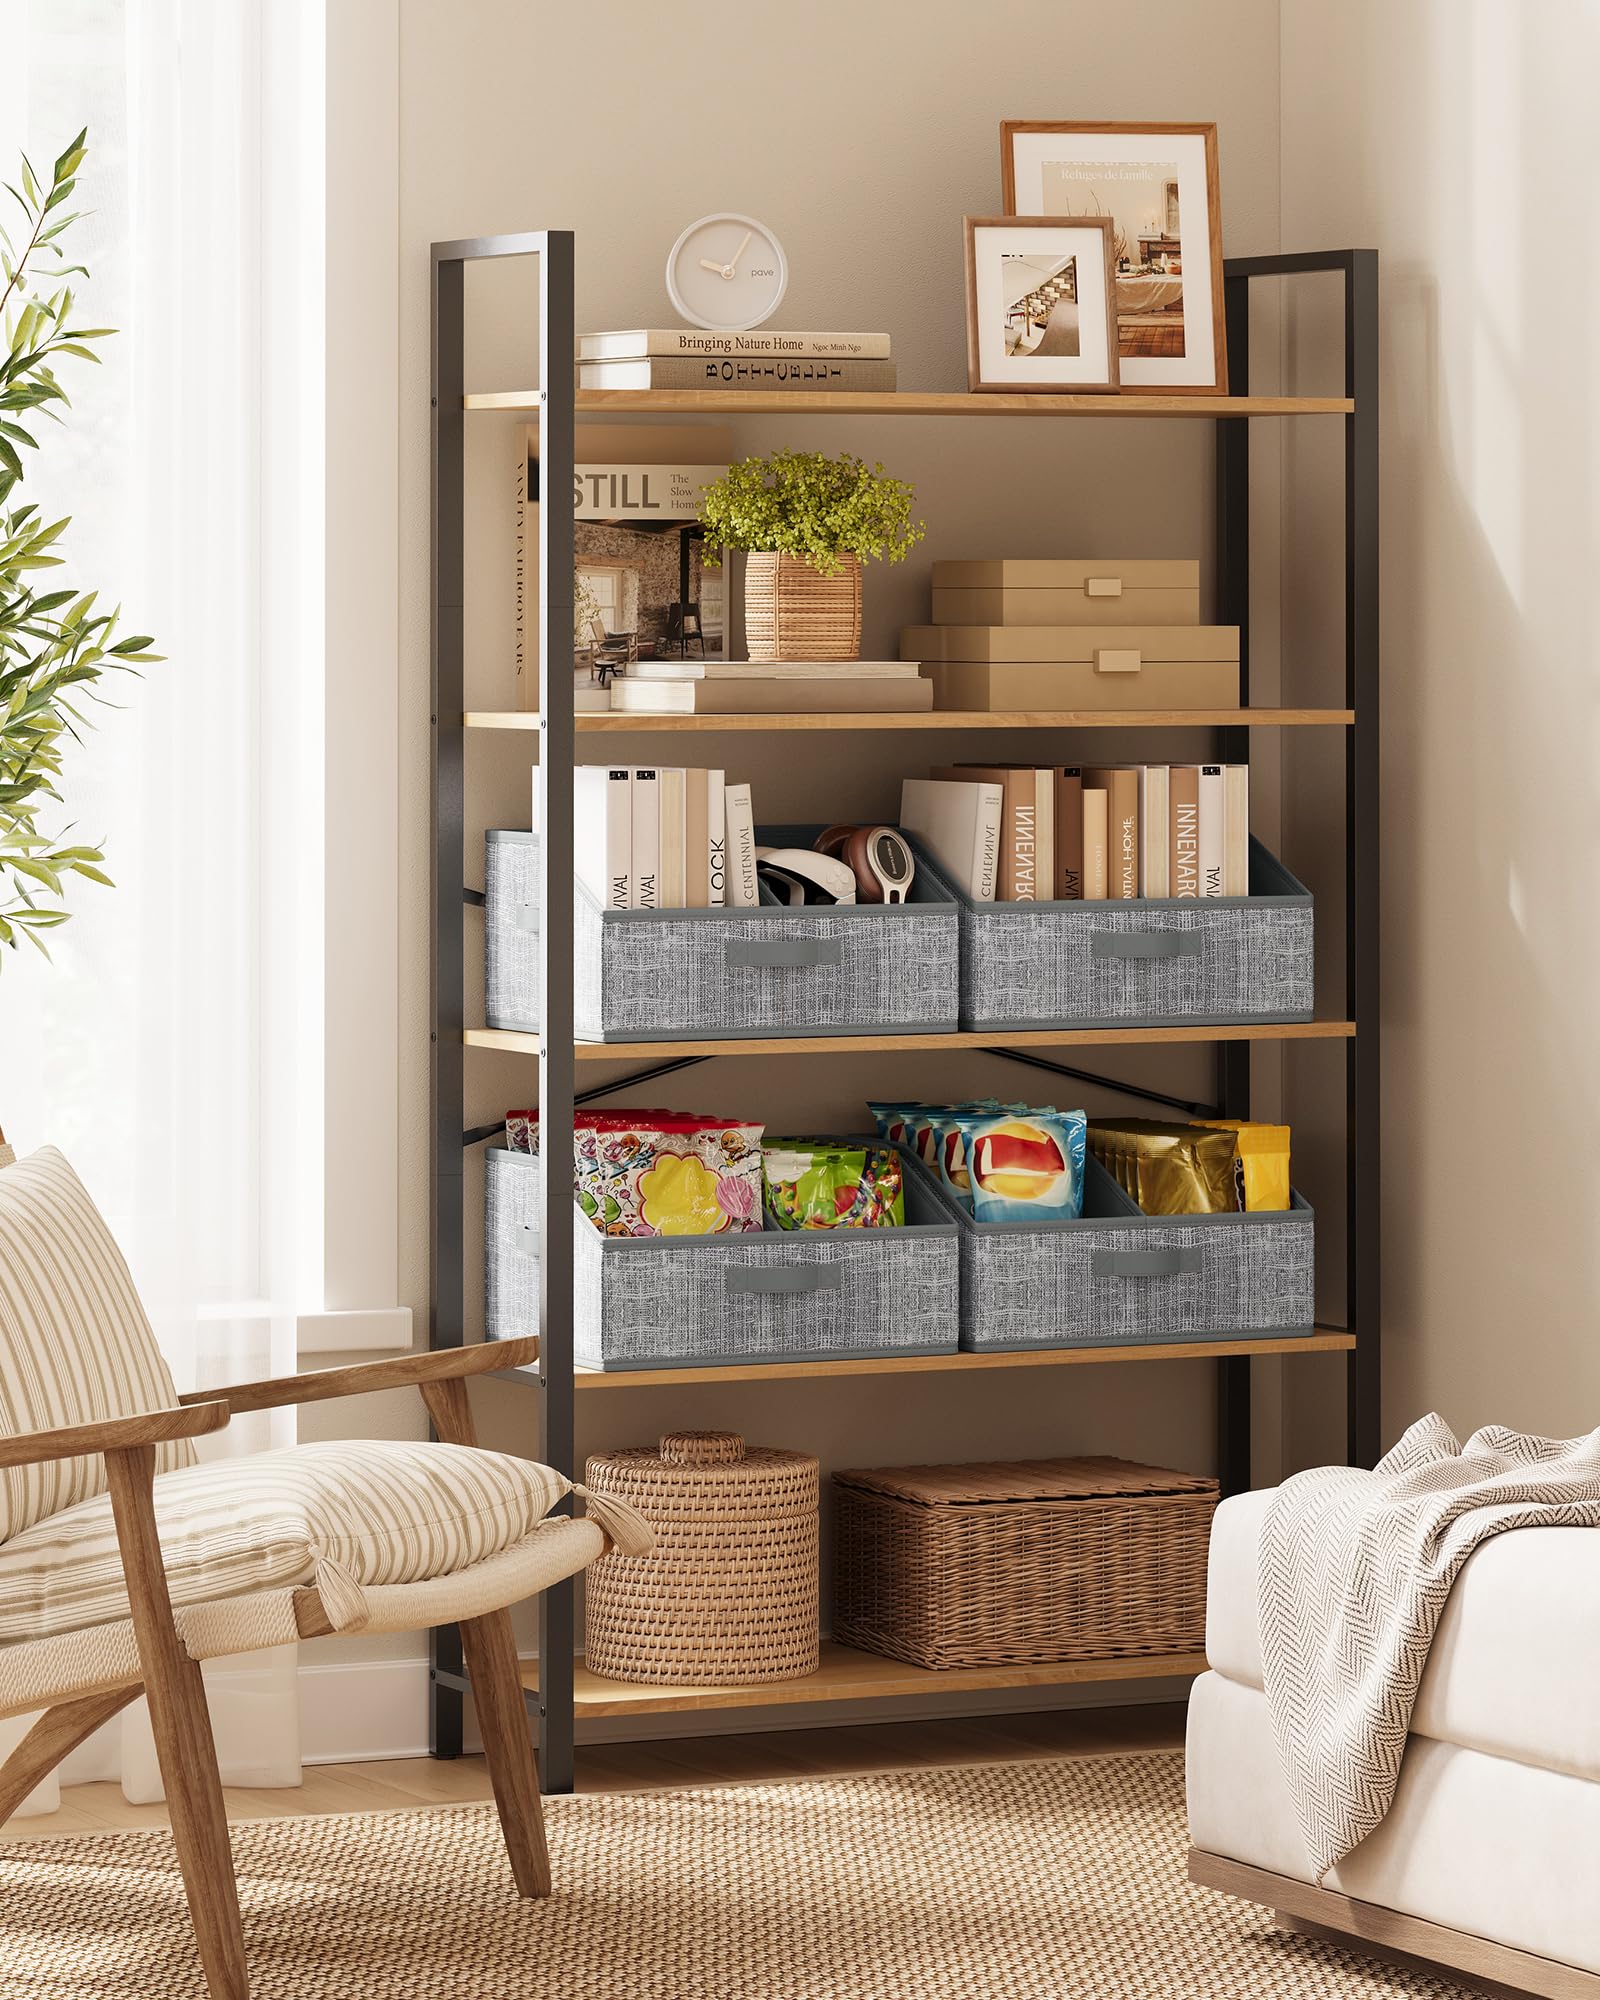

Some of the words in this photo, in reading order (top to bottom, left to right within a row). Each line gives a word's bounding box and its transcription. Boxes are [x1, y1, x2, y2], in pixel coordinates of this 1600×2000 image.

[1104, 170, 1118, 180] de
[751, 268, 774, 278] pave
[679, 335, 732, 353] Bringing
[735, 336, 771, 351] Nature
[773, 337, 804, 351] Home
[830, 343, 847, 352] Minh
[848, 344, 862, 354] Ngo
[706, 361, 842, 382] BOTTICELLI
[670, 474, 689, 484] The
[670, 487, 693, 497] Slow
[671, 500, 701, 509] Home
[1122, 816, 1132, 860] HOME
[739, 826, 755, 900] CENTENNIAL
